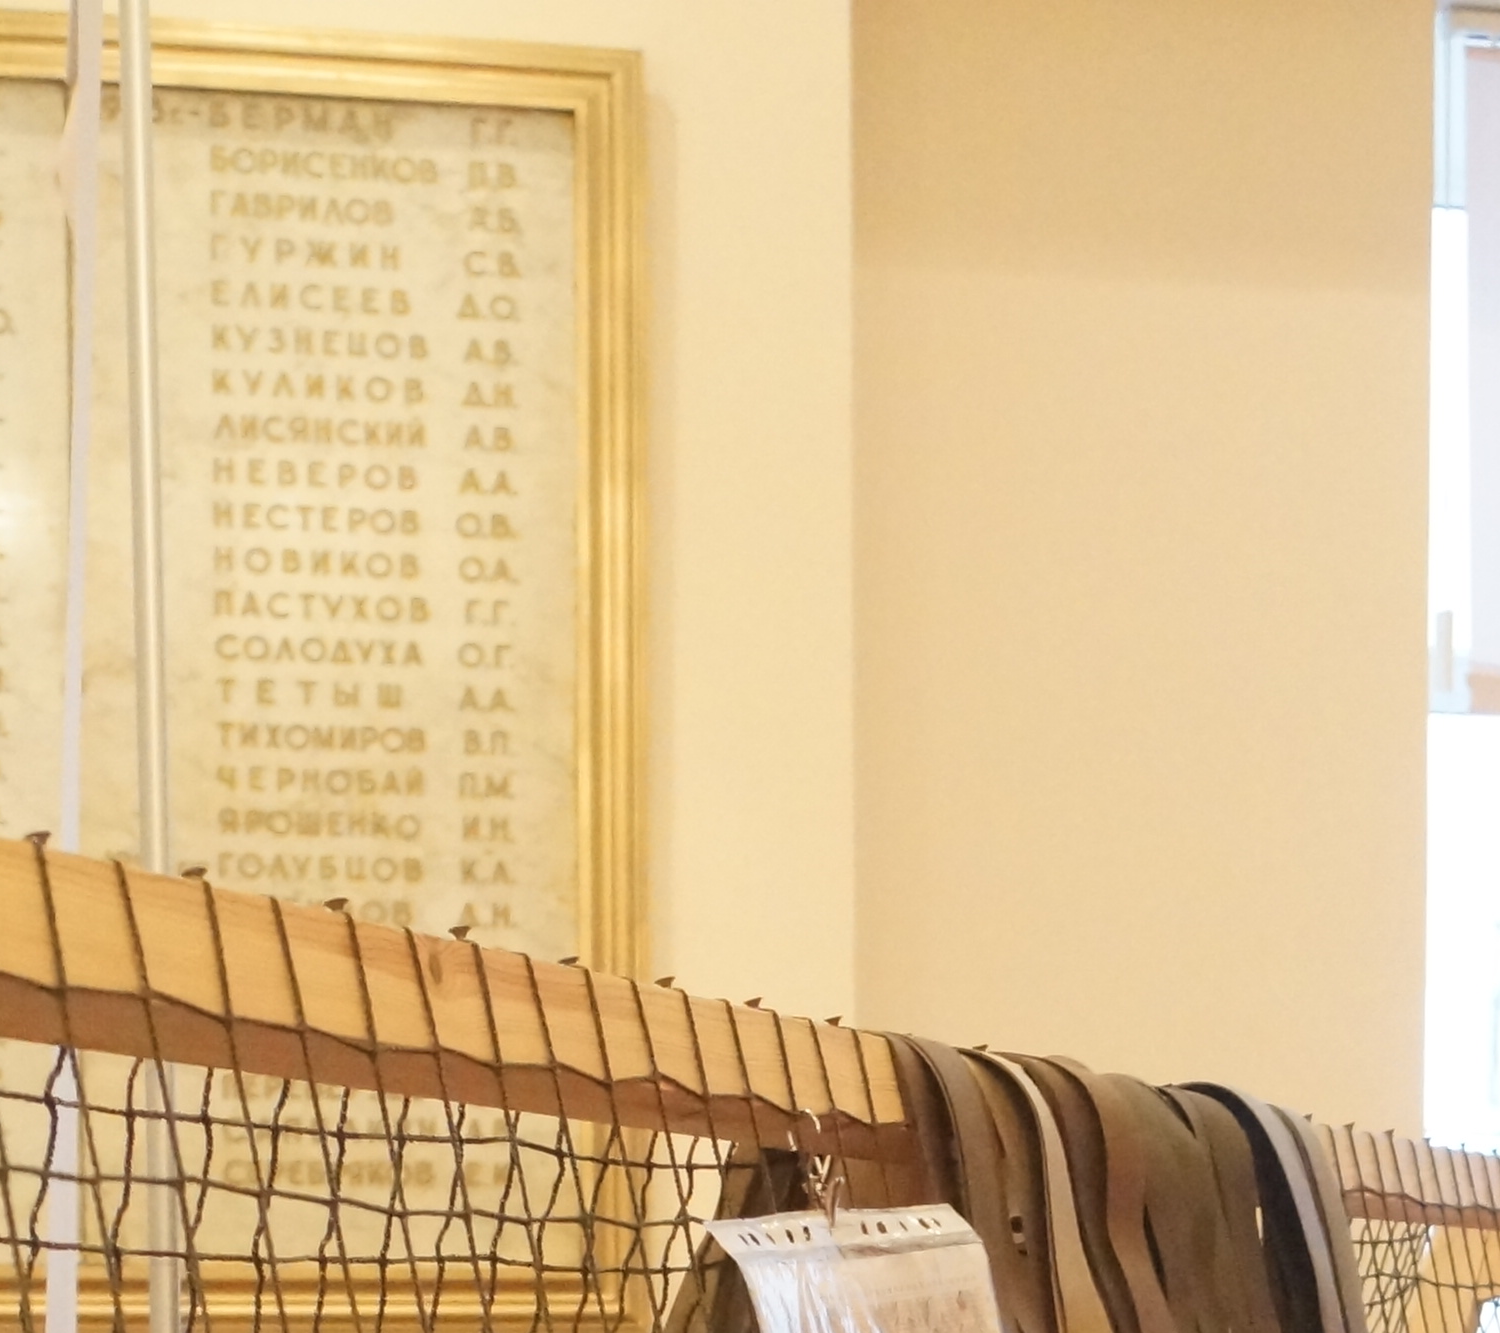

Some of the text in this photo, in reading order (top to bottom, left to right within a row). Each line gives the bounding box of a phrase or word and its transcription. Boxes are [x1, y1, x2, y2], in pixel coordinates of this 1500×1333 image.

[209, 147, 438, 184] БОРИСЕНКОВ
[209, 190, 393, 225] ГАВРИЛОВ
[209, 233, 401, 269] ГУРЖИН
[210, 280, 411, 316] ЕЛИСЕЕВ
[211, 324, 429, 360] КУЗНЕЦОВ
[210, 370, 424, 404] КУЛИКОВ
[214, 413, 427, 449] ЛИСЯНСКИЙ
[212, 458, 419, 490] НЕВЕРОВ
[212, 504, 421, 534] НЕСТЕРОВ
[213, 547, 421, 579] НОВИКОВ
[214, 592, 430, 624] ПАСТУХОВ
[215, 635, 423, 666] СОЛОДУХА
[216, 677, 404, 709] ТЕТЫШ
[216, 722, 426, 753] ТИХОМИРОВ
[216, 765, 424, 798] ЧЕРНОБАЙ
[218, 809, 421, 841] ЯРОШЕНКО
[218, 853, 423, 883] ГОЛУБЦОВ
